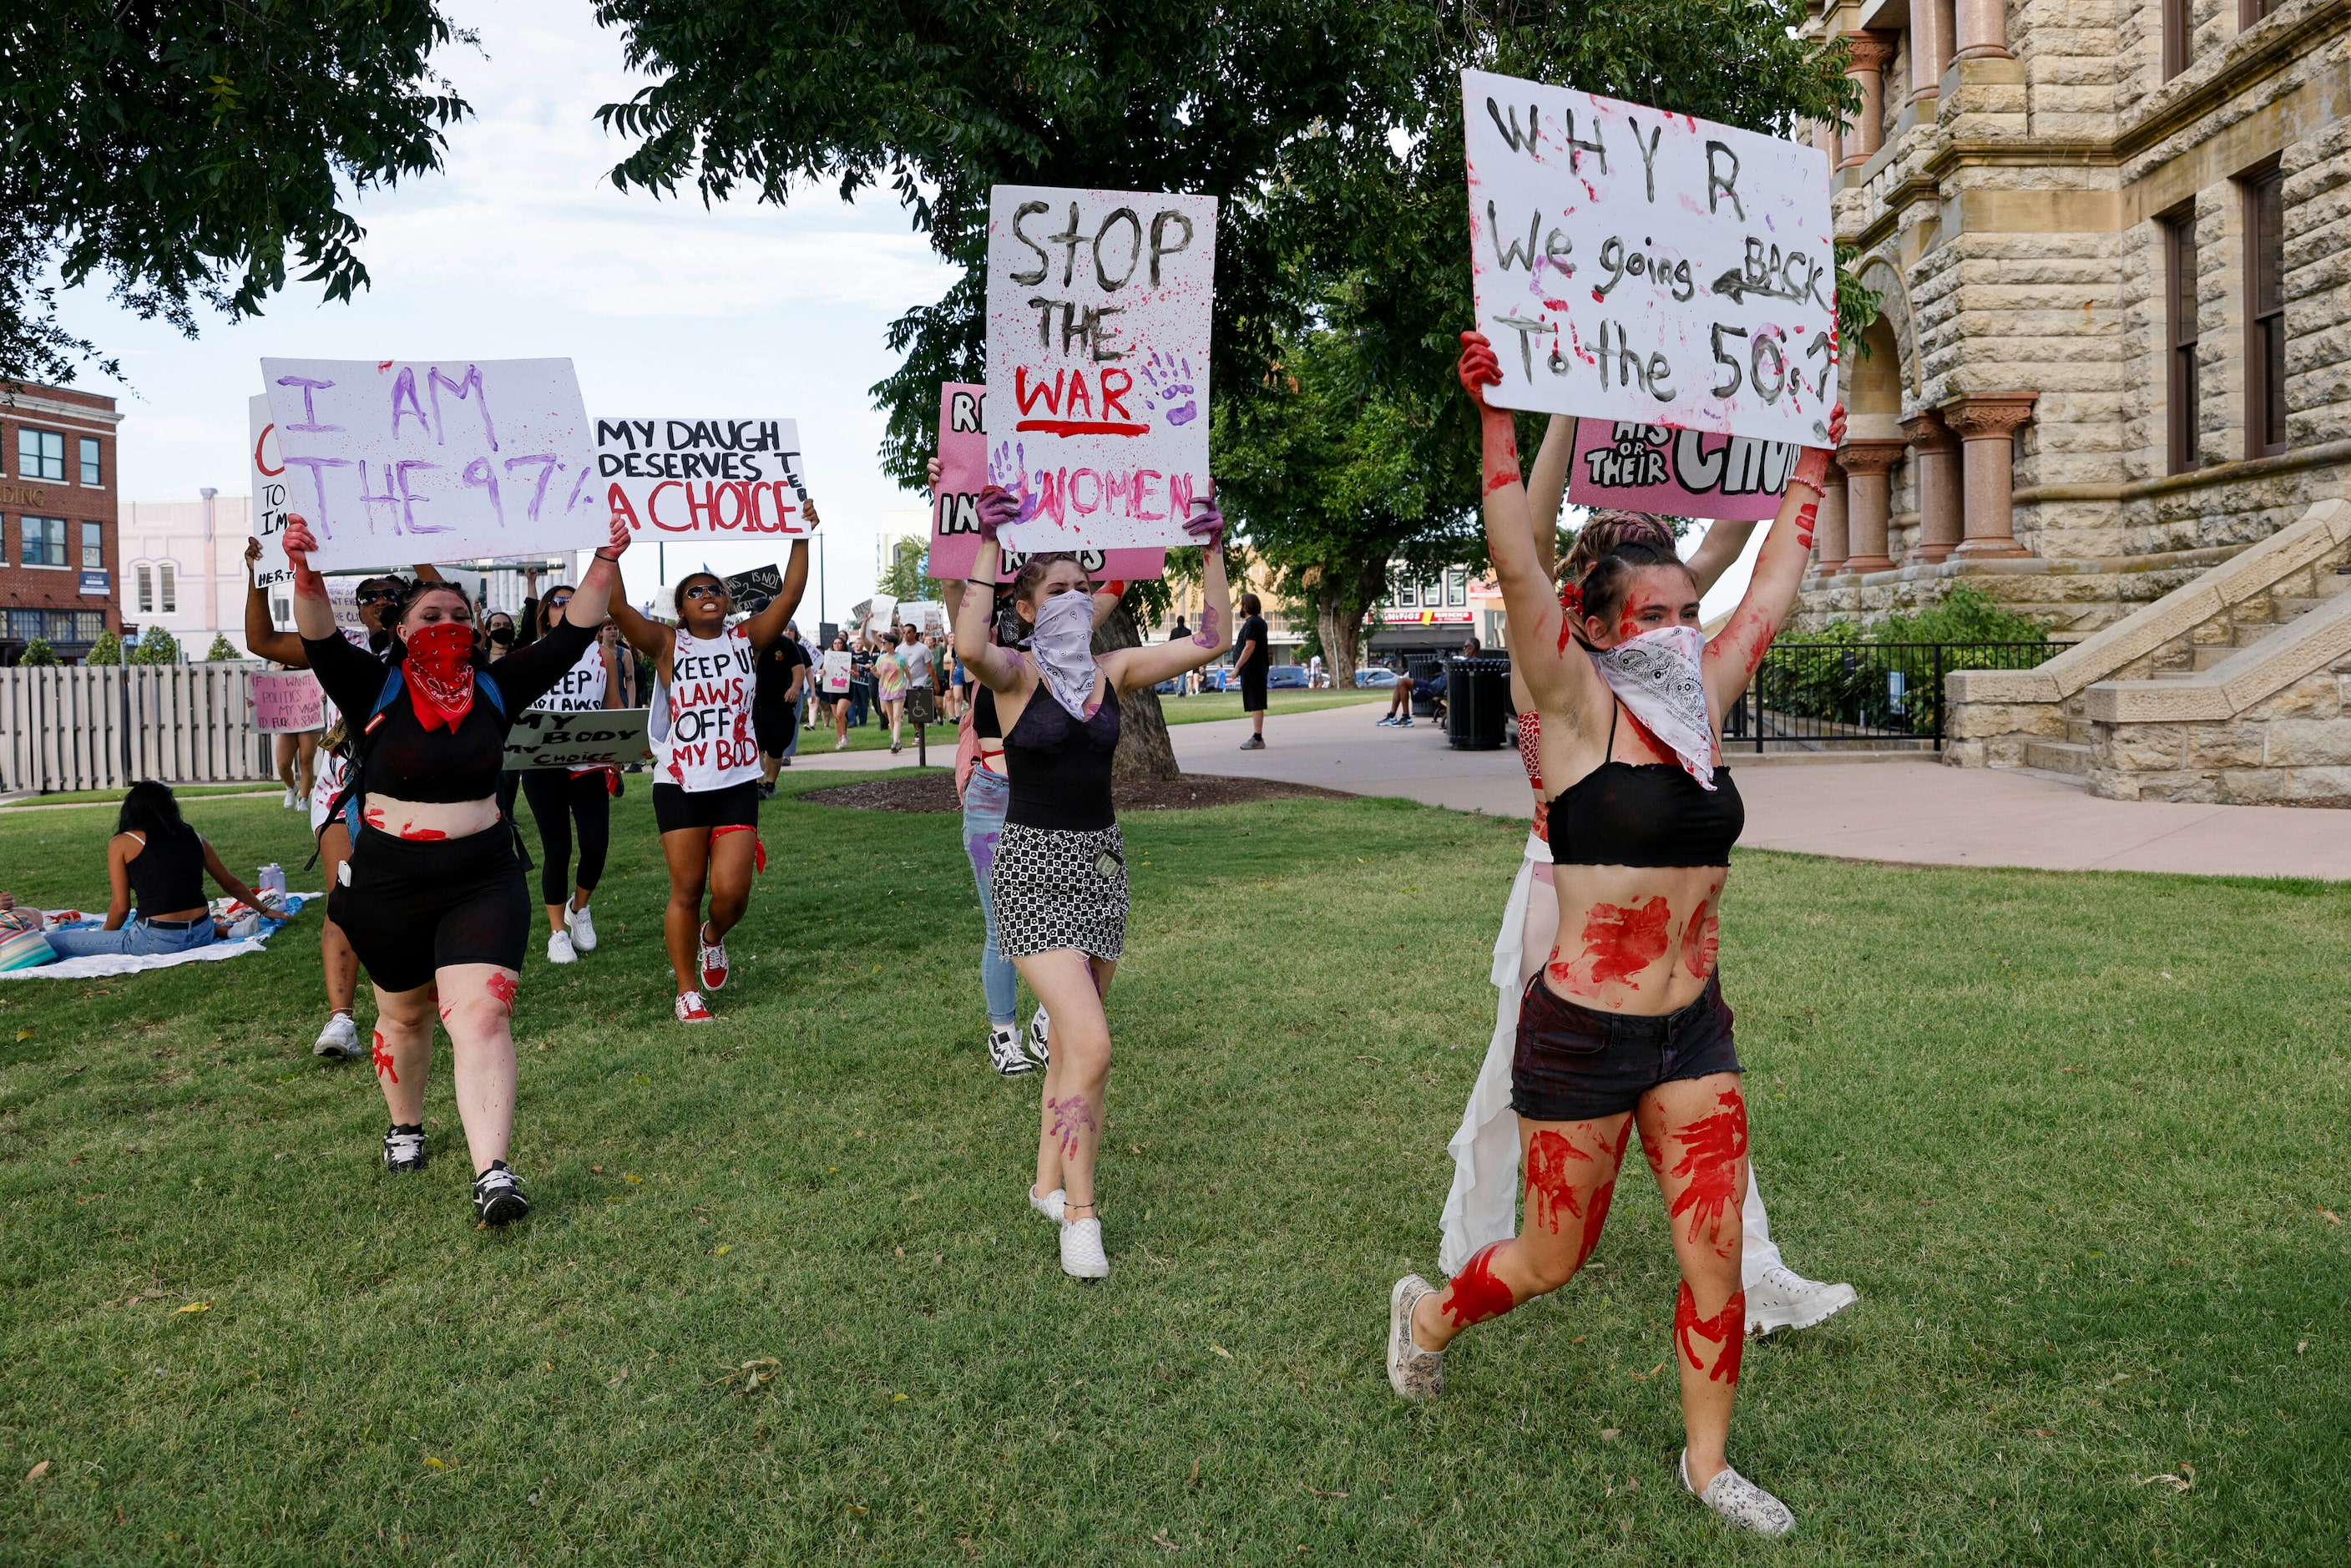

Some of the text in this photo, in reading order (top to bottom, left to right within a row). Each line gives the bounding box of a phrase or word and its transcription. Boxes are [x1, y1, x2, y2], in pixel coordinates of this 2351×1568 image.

[1486, 97, 1746, 222] WHY R
[1488, 200, 1832, 314] We going BACK
[1028, 296, 1139, 366] THE
[1493, 314, 1571, 385] To
[1585, 318, 1677, 402] the
[277, 364, 498, 452] I AM
[1015, 366, 1131, 422] WAR
[598, 419, 781, 452] MY DAUGH
[1618, 442, 1646, 457] OR
[598, 452, 762, 482] DESERVES
[1585, 448, 1670, 488] THEIR
[262, 483, 286, 509] TO
[283, 456, 457, 541] THE
[608, 480, 803, 534] A CHOICE
[1015, 466, 1194, 531] WOMEN
[258, 569, 284, 586] HER
[751, 572, 761, 583] IS
[761, 572, 780, 587] NOT
[251, 675, 262, 687] IF
[672, 654, 731, 683] KEEP
[261, 687, 317, 704] POLITICS IN
[680, 677, 744, 708] LAWS
[272, 716, 290, 729] FUCK
[293, 716, 299, 726] A
[278, 705, 294, 716] MY
[675, 707, 731, 742] OFF
[541, 730, 641, 745] BODY
[672, 741, 708, 766] MY
